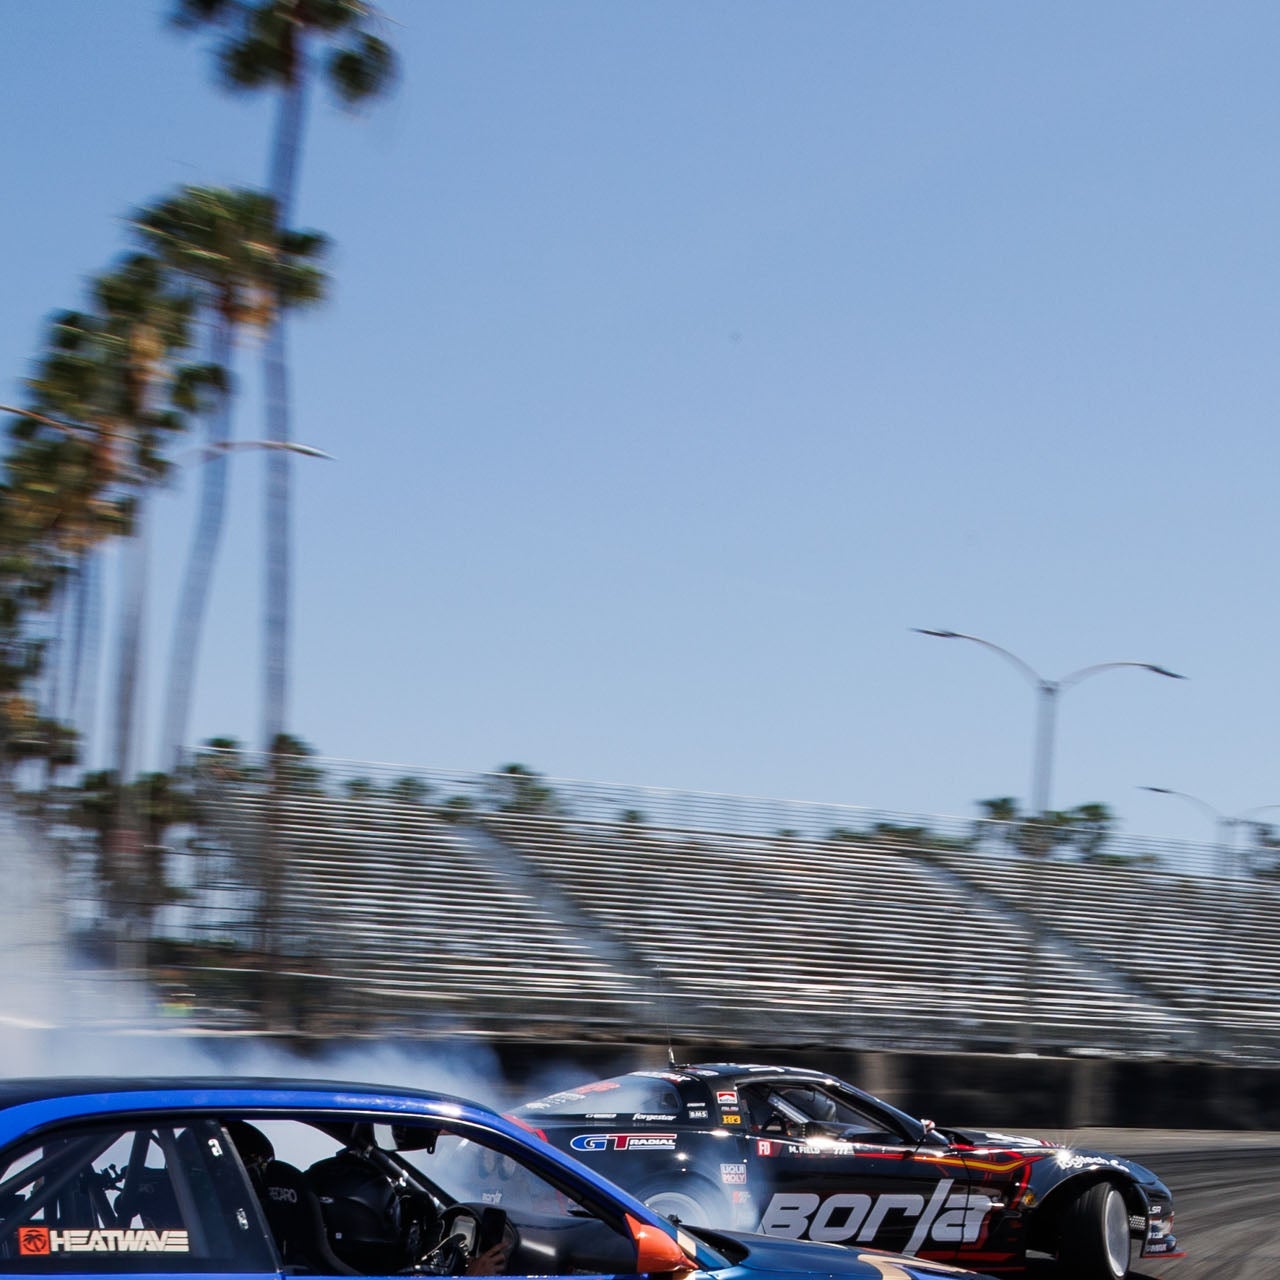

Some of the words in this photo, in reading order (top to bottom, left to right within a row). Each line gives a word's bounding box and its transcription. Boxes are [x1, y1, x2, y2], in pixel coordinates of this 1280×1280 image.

[570, 1133, 630, 1150] GT
[629, 1139, 676, 1147] RADIAL
[758, 1141, 771, 1155] FD
[50, 1230, 190, 1253] HEATWAVE
